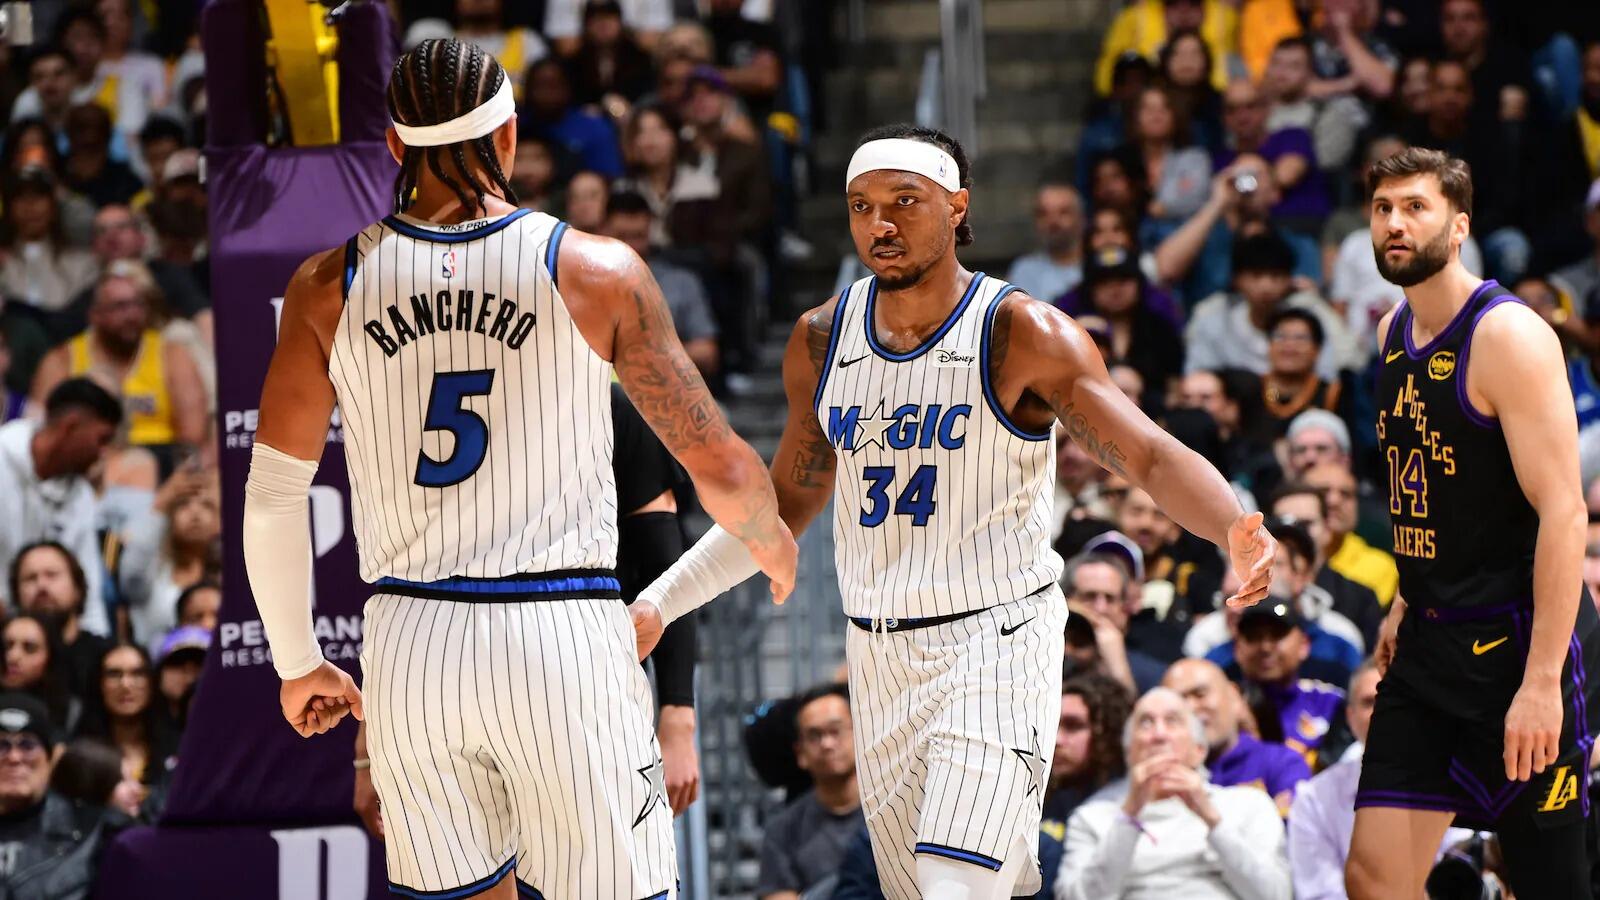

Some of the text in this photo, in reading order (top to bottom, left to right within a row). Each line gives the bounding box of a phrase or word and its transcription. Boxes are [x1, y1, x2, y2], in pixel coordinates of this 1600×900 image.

[466, 221, 489, 231] PRO
[364, 290, 536, 358] BANCHERO
[414, 369, 495, 488] 5
[1393, 374, 1456, 475] ANGELES
[859, 465, 937, 528] 34
[1387, 445, 1428, 518] 14
[1392, 524, 1436, 559] AKERS
[1538, 765, 1578, 812] LA
